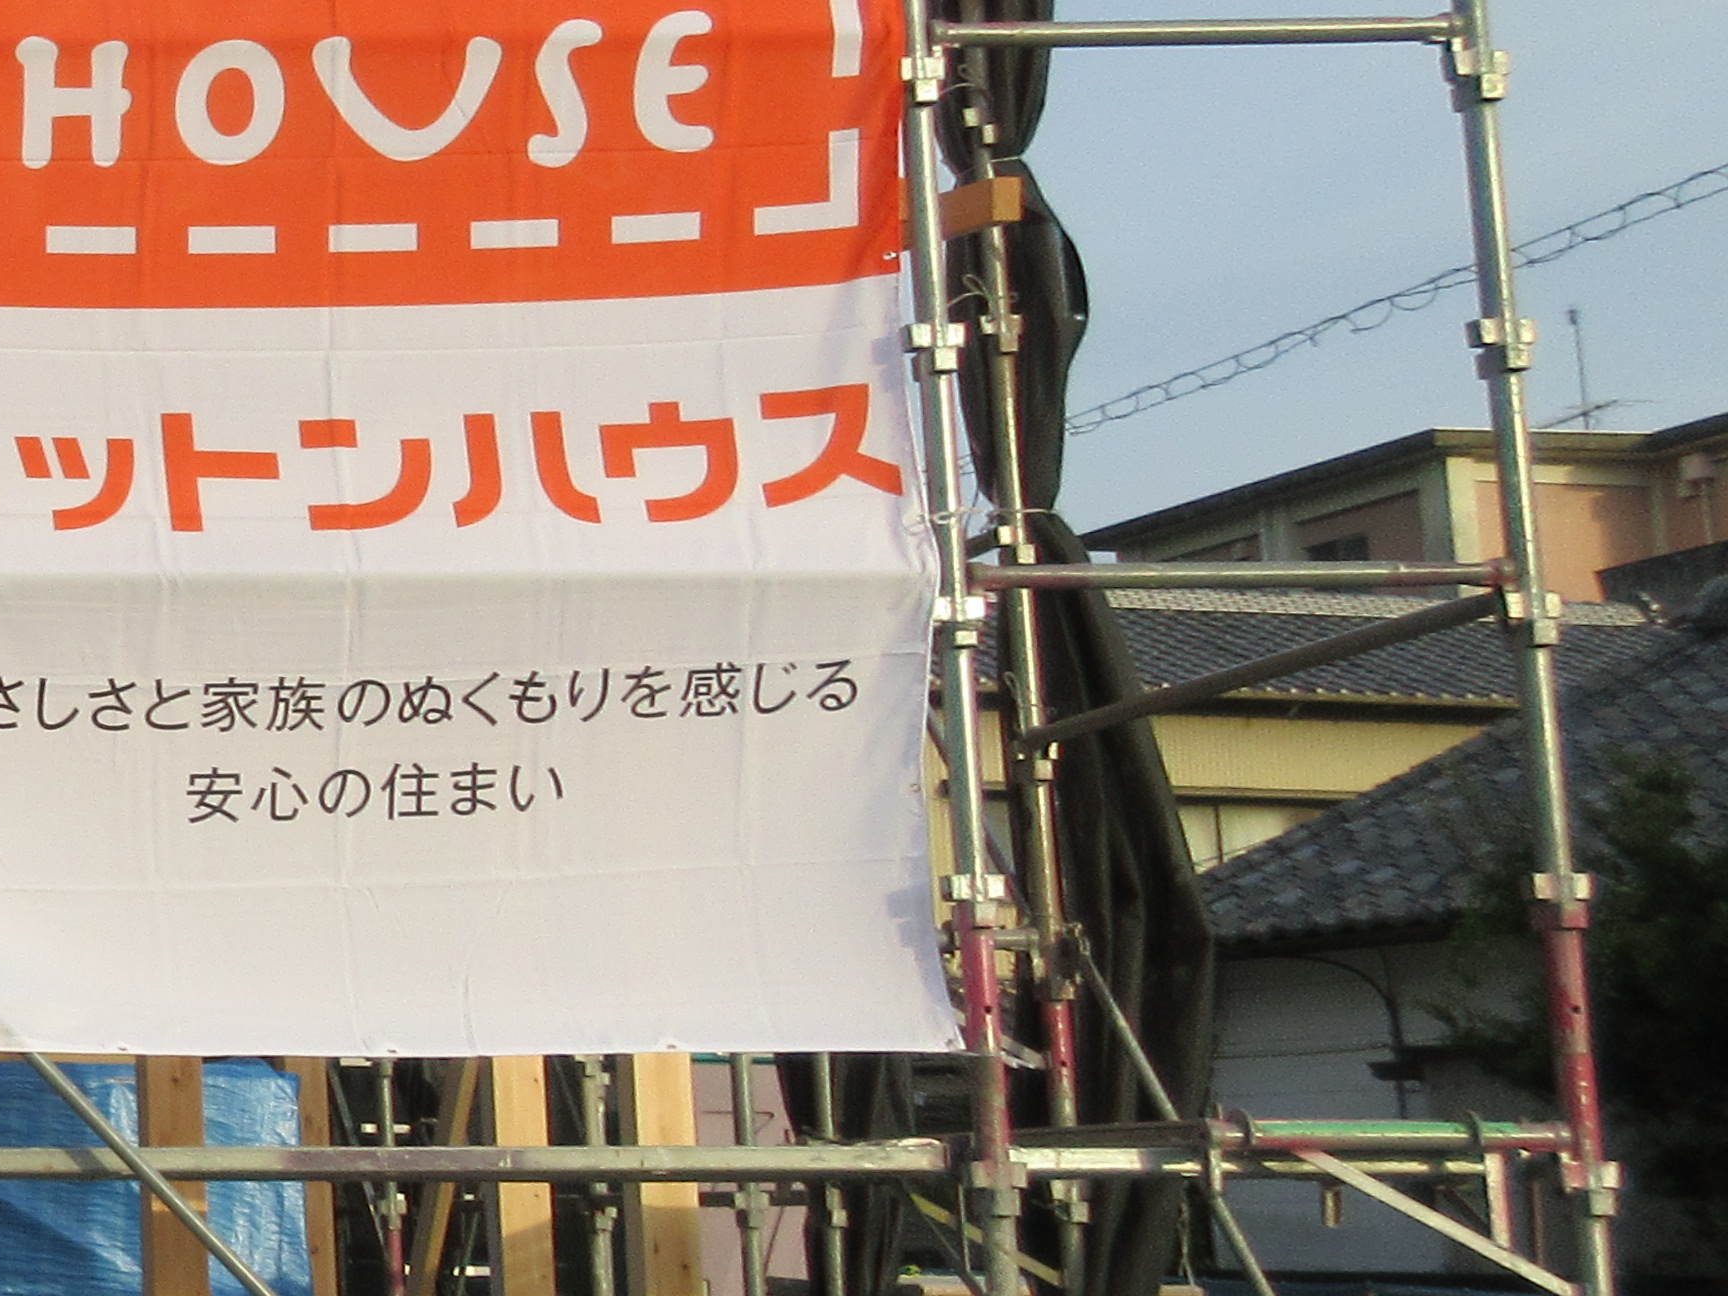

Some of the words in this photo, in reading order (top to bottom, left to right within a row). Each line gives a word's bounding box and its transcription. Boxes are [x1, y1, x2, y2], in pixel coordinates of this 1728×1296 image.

[17, 11, 714, 168] HOUSE
[187, 763, 562, 823] 安心の住まい
